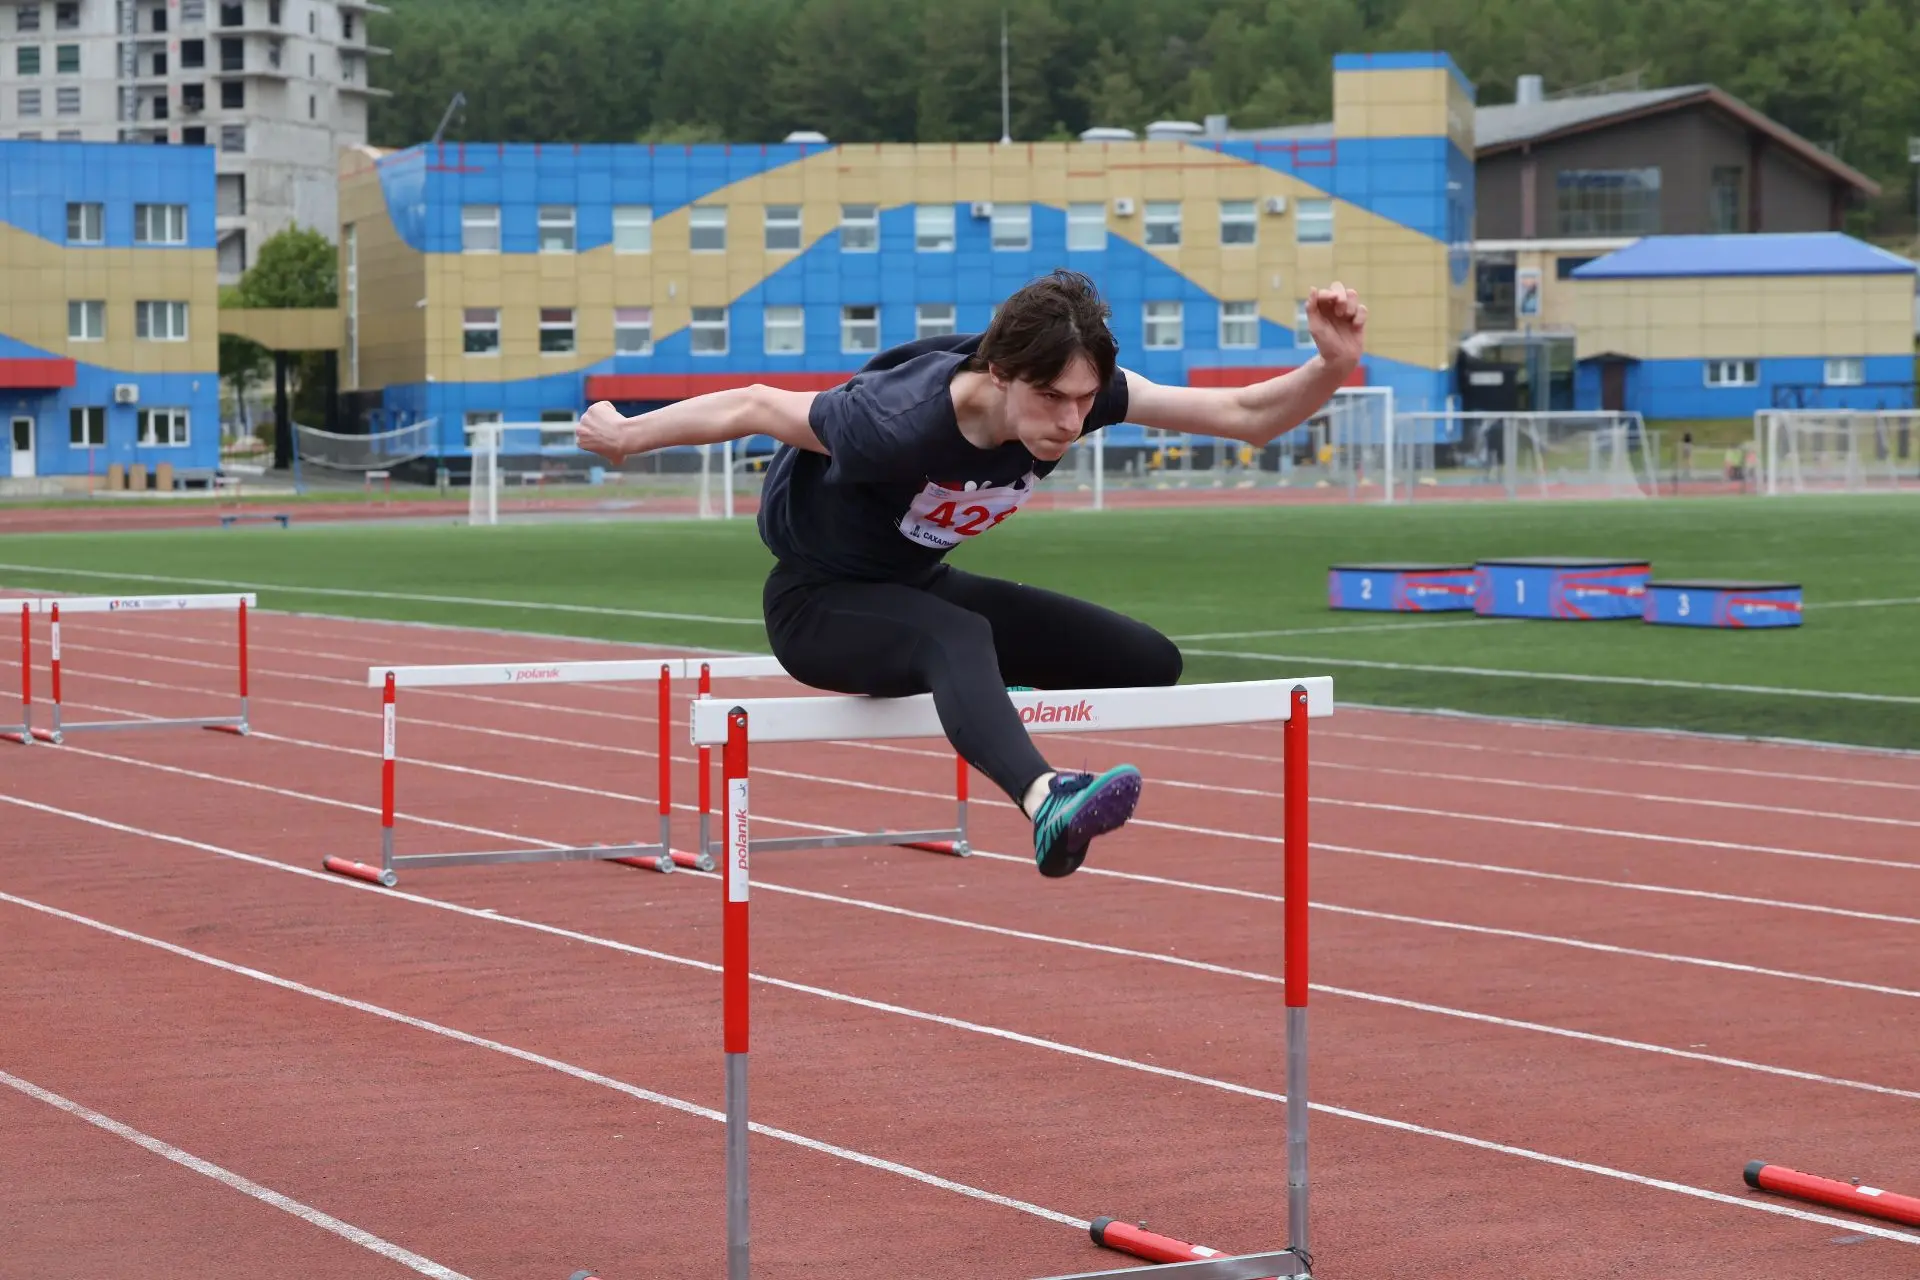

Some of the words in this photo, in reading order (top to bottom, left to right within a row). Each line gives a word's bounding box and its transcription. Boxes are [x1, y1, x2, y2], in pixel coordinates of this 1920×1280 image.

[1361, 578, 1372, 600] 2
[1516, 579, 1525, 604] 1
[1678, 593, 1690, 617] 3
[516, 668, 560, 682] polanik
[1018, 700, 1094, 724] olanik
[735, 808, 749, 870] polanik
